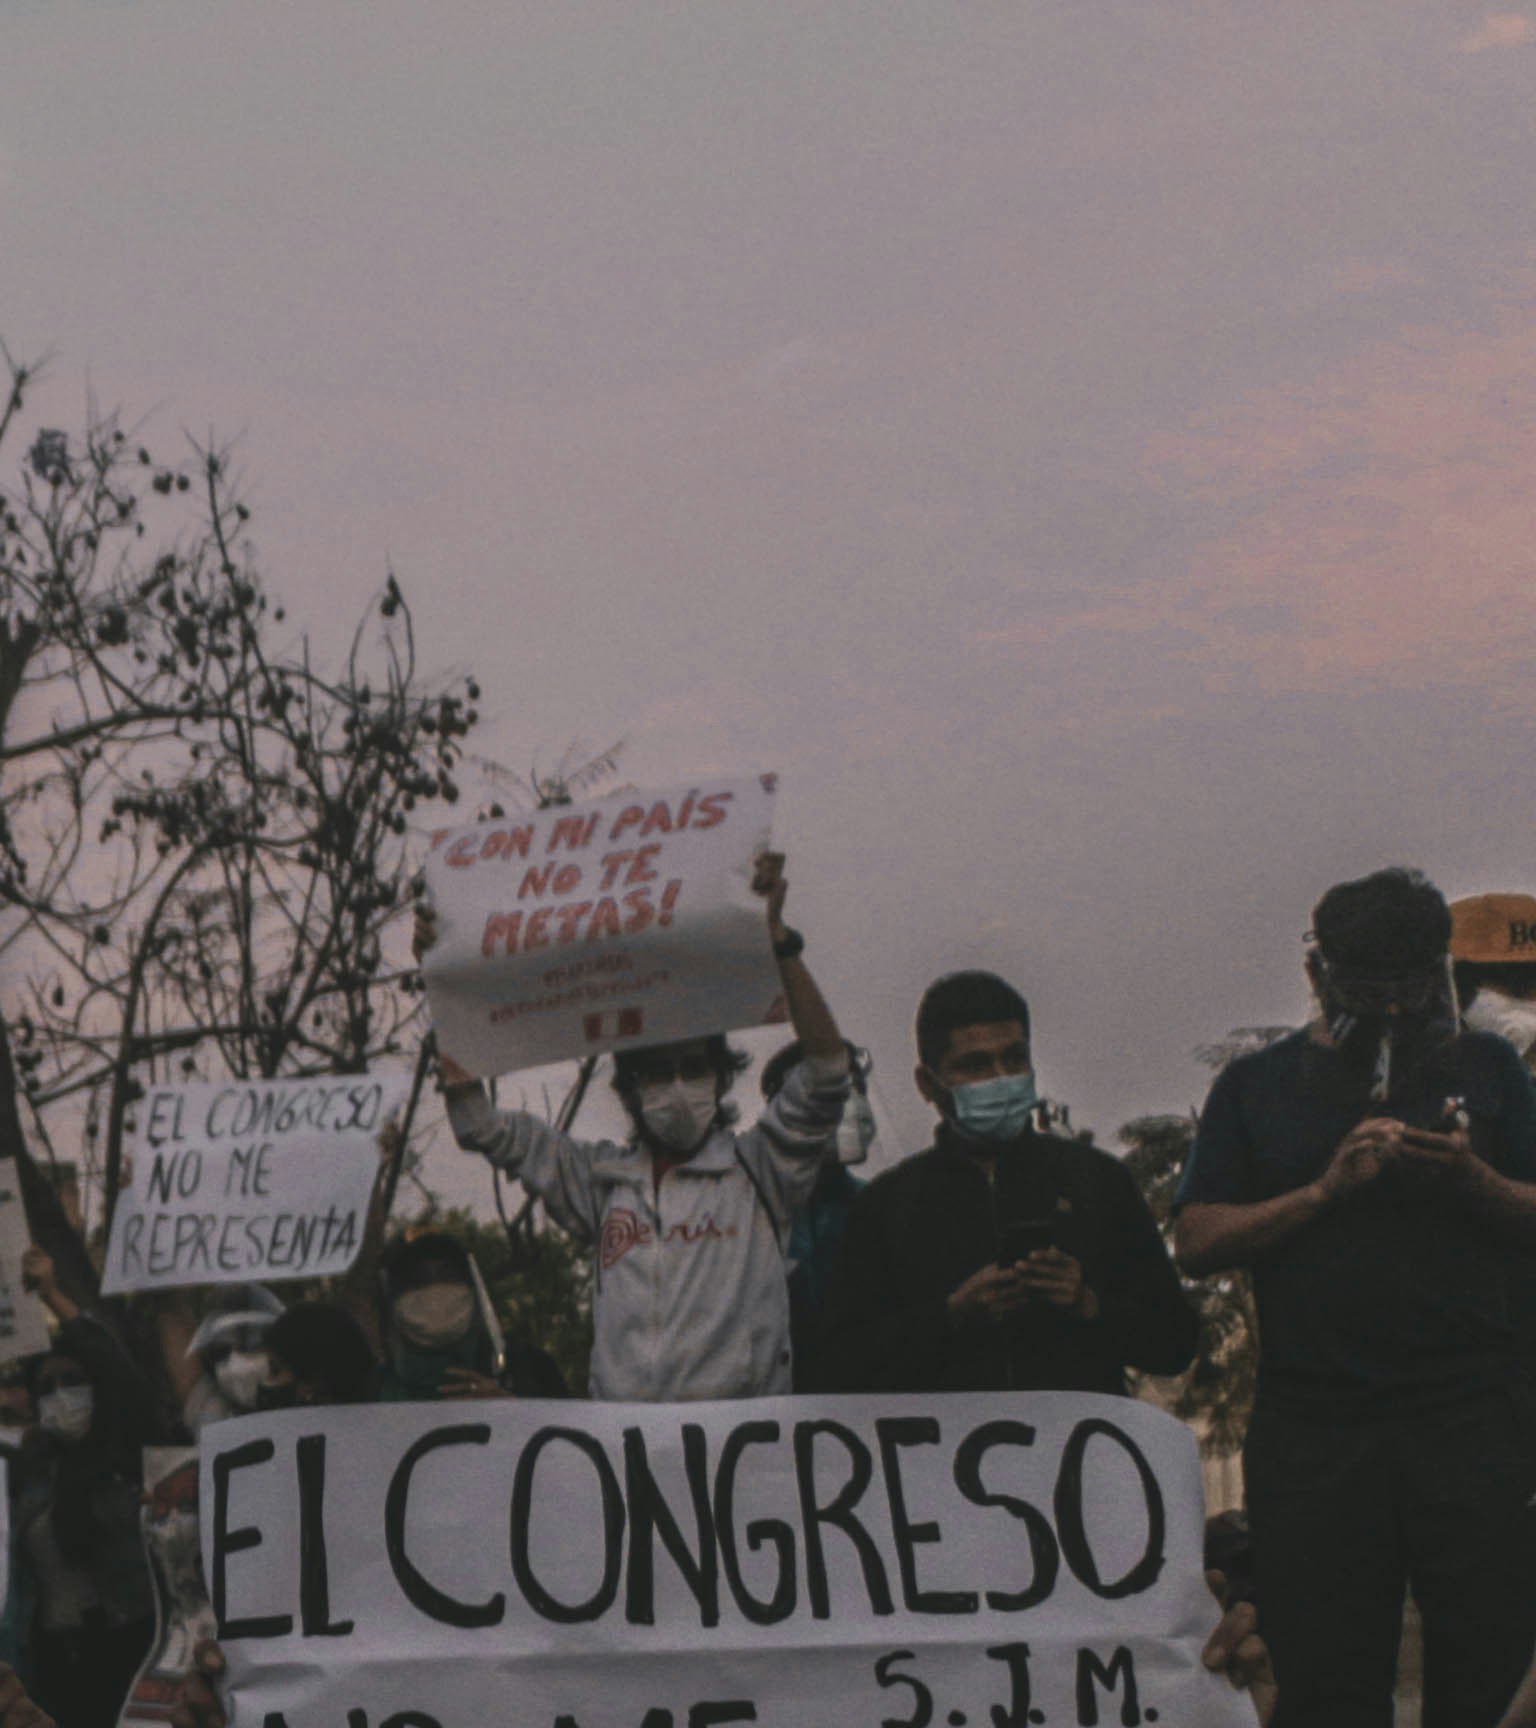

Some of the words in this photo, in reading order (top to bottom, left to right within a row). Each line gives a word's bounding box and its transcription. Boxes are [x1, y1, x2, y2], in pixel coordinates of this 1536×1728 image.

[546, 811, 602, 854] MI
[517, 859, 583, 900] NO
[599, 842, 663, 892] TE
[480, 878, 684, 959] METAS!
[146, 1091, 185, 1148] EL
[206, 1083, 383, 1139] CONGRESO
[146, 1150, 203, 1205] NO
[225, 1143, 274, 1197] ME
[212, 1434, 355, 1640] EL
[384, 1416, 1166, 1629] CONGRESO
